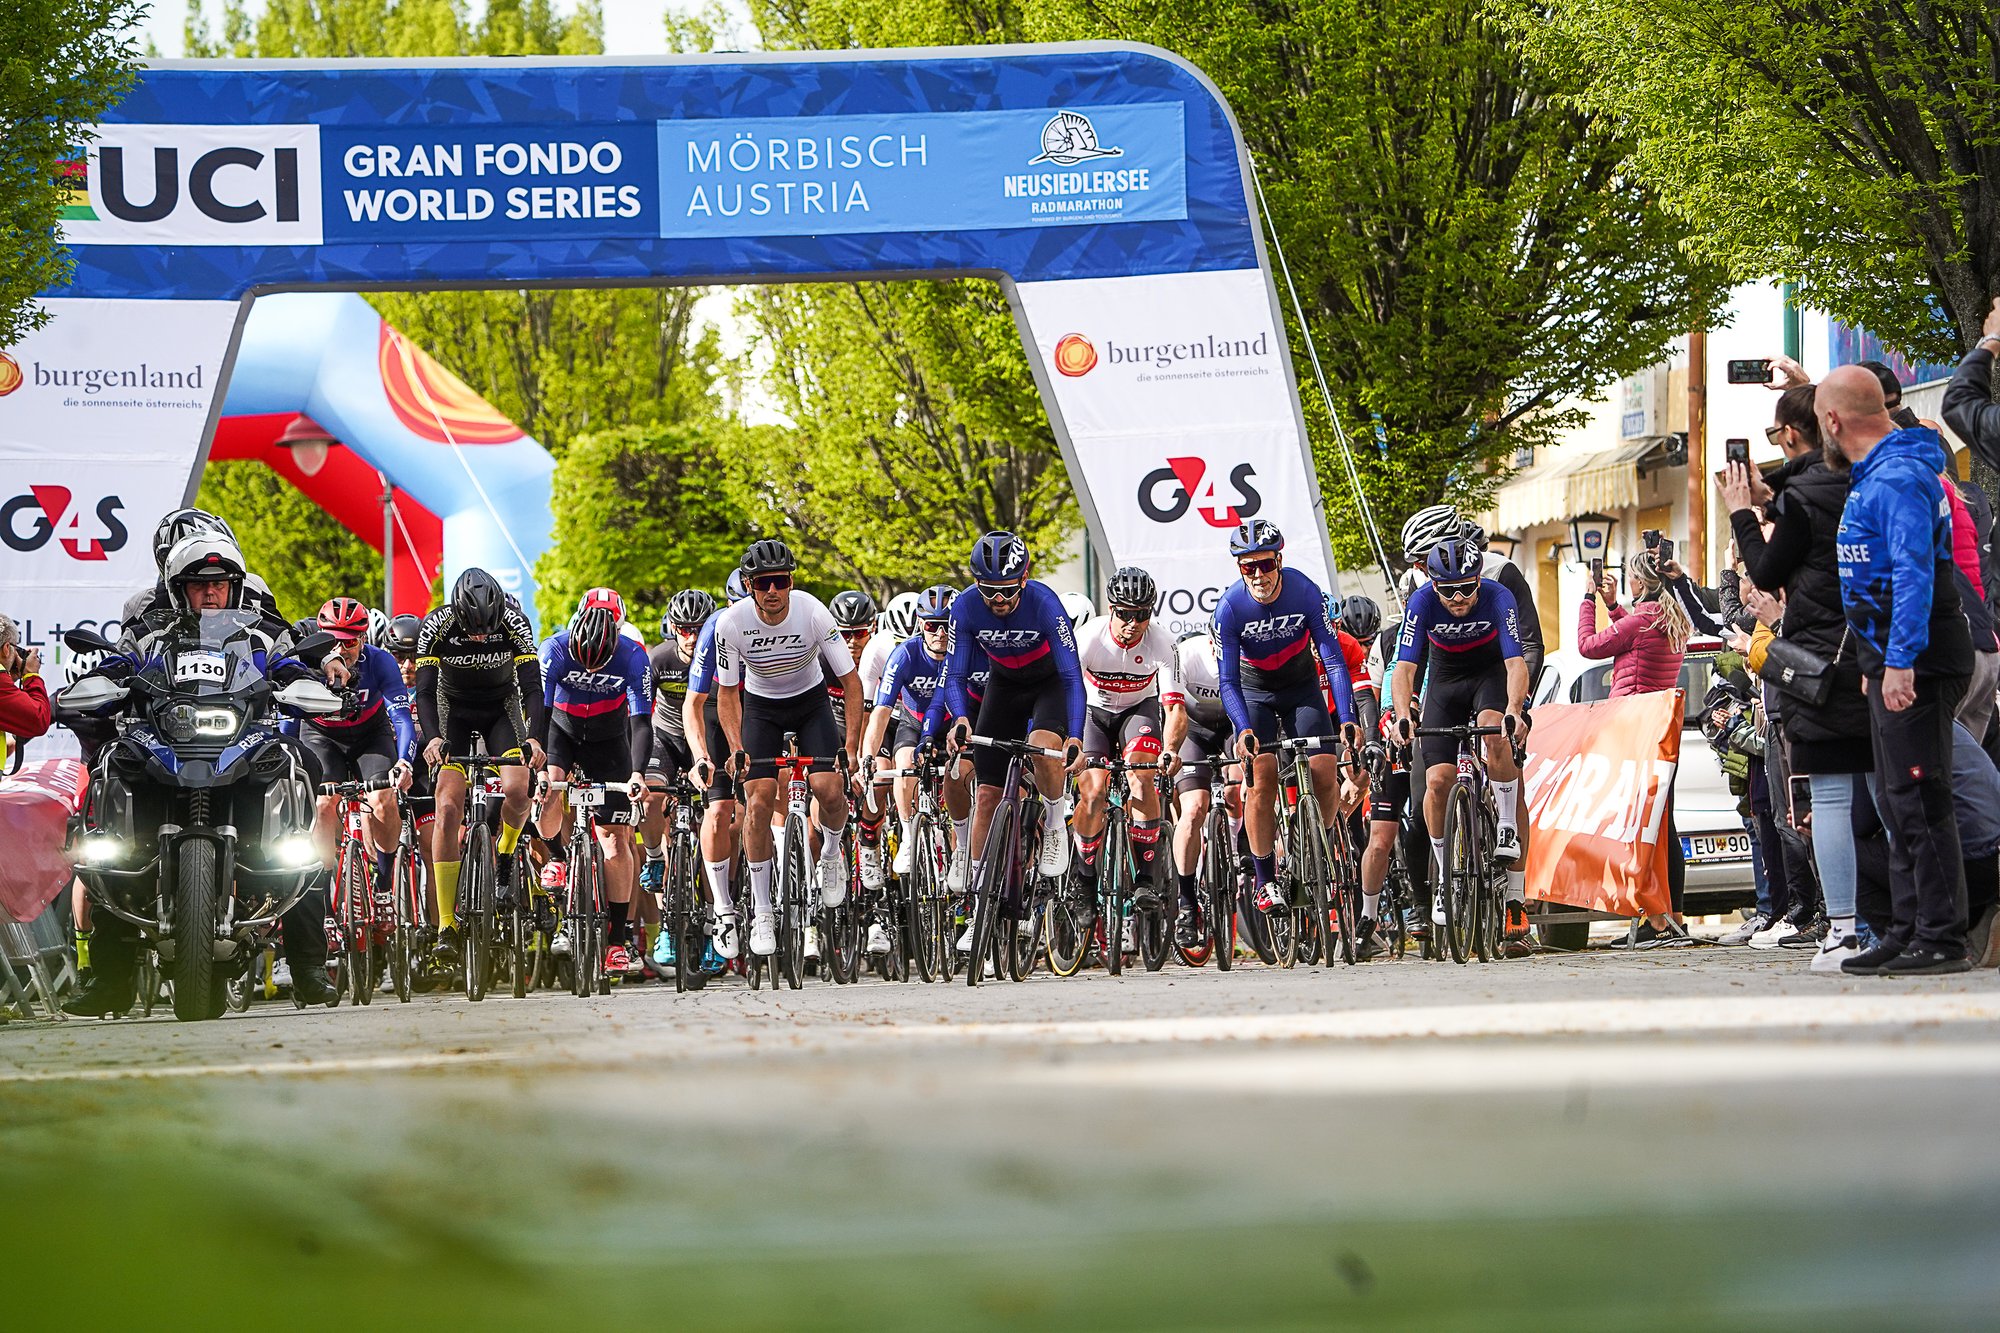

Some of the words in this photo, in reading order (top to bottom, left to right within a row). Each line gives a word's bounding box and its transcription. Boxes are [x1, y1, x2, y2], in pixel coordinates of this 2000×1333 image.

[344, 144, 462, 177] GRAN
[475, 141, 622, 176] FONDO
[687, 132, 927, 173] MÖRBISCH
[99, 147, 299, 223] UCI
[686, 180, 870, 217] AUSTRIA
[1004, 169, 1149, 198] NEUSIEDLERSEE
[344, 188, 494, 222] WORLD
[505, 185, 641, 219] SERIES
[1031, 198, 1123, 214] RADMARATHON
[1107, 332, 1268, 368] burgenland
[33, 362, 203, 394] burgenland
[1137, 372, 1152, 382] die
[1155, 369, 1212, 382] sonnenseite
[1214, 366, 1269, 378] österreichs
[63, 398, 79, 407] die
[82, 399, 143, 408] sonnenseite
[146, 397, 203, 409] österreichs
[1138, 456, 1262, 528] G4S
[0, 485, 128, 561] G4S
[416, 606, 453, 655] KIRCHMAIR
[947, 614, 957, 656] BMC
[976, 630, 1041, 641] RH77
[1056, 615, 1076, 652] FACTORY
[1241, 613, 1306, 637] RH77
[1401, 609, 1418, 647] BMC
[1430, 621, 1492, 633] RH77
[442, 651, 511, 666] KIRCHMAIR
[716, 632, 729, 670] BMC
[178, 662, 225, 677] 1130
[562, 670, 625, 689] RH77
[880, 659, 899, 695] BMC
[581, 793, 594, 803] 10
[1694, 838, 1716, 855] EU
[1728, 835, 1749, 852] 90
